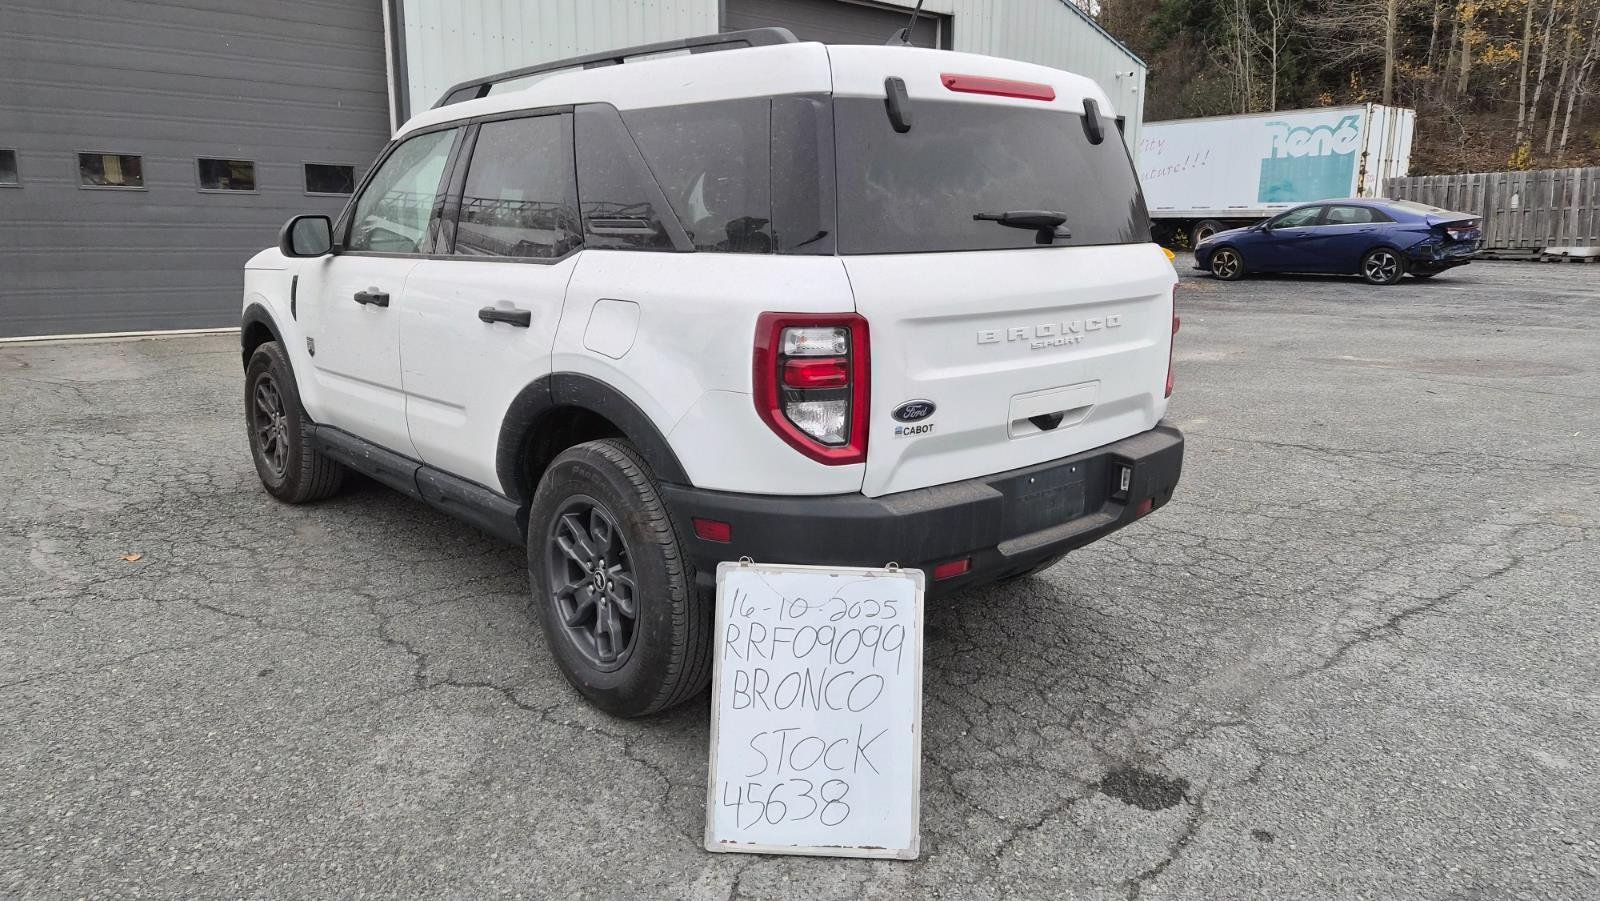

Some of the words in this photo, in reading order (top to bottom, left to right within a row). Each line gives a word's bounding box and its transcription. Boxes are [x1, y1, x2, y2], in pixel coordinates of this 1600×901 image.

[977, 314, 1121, 344] BRONCO
[1030, 336, 1083, 350] SPORT
[903, 423, 934, 436] CABOT
[724, 621, 906, 675] RRF09099
[732, 666, 885, 713] BRONCO
[745, 723, 889, 778] STOCK
[723, 778, 851, 831] 45638
